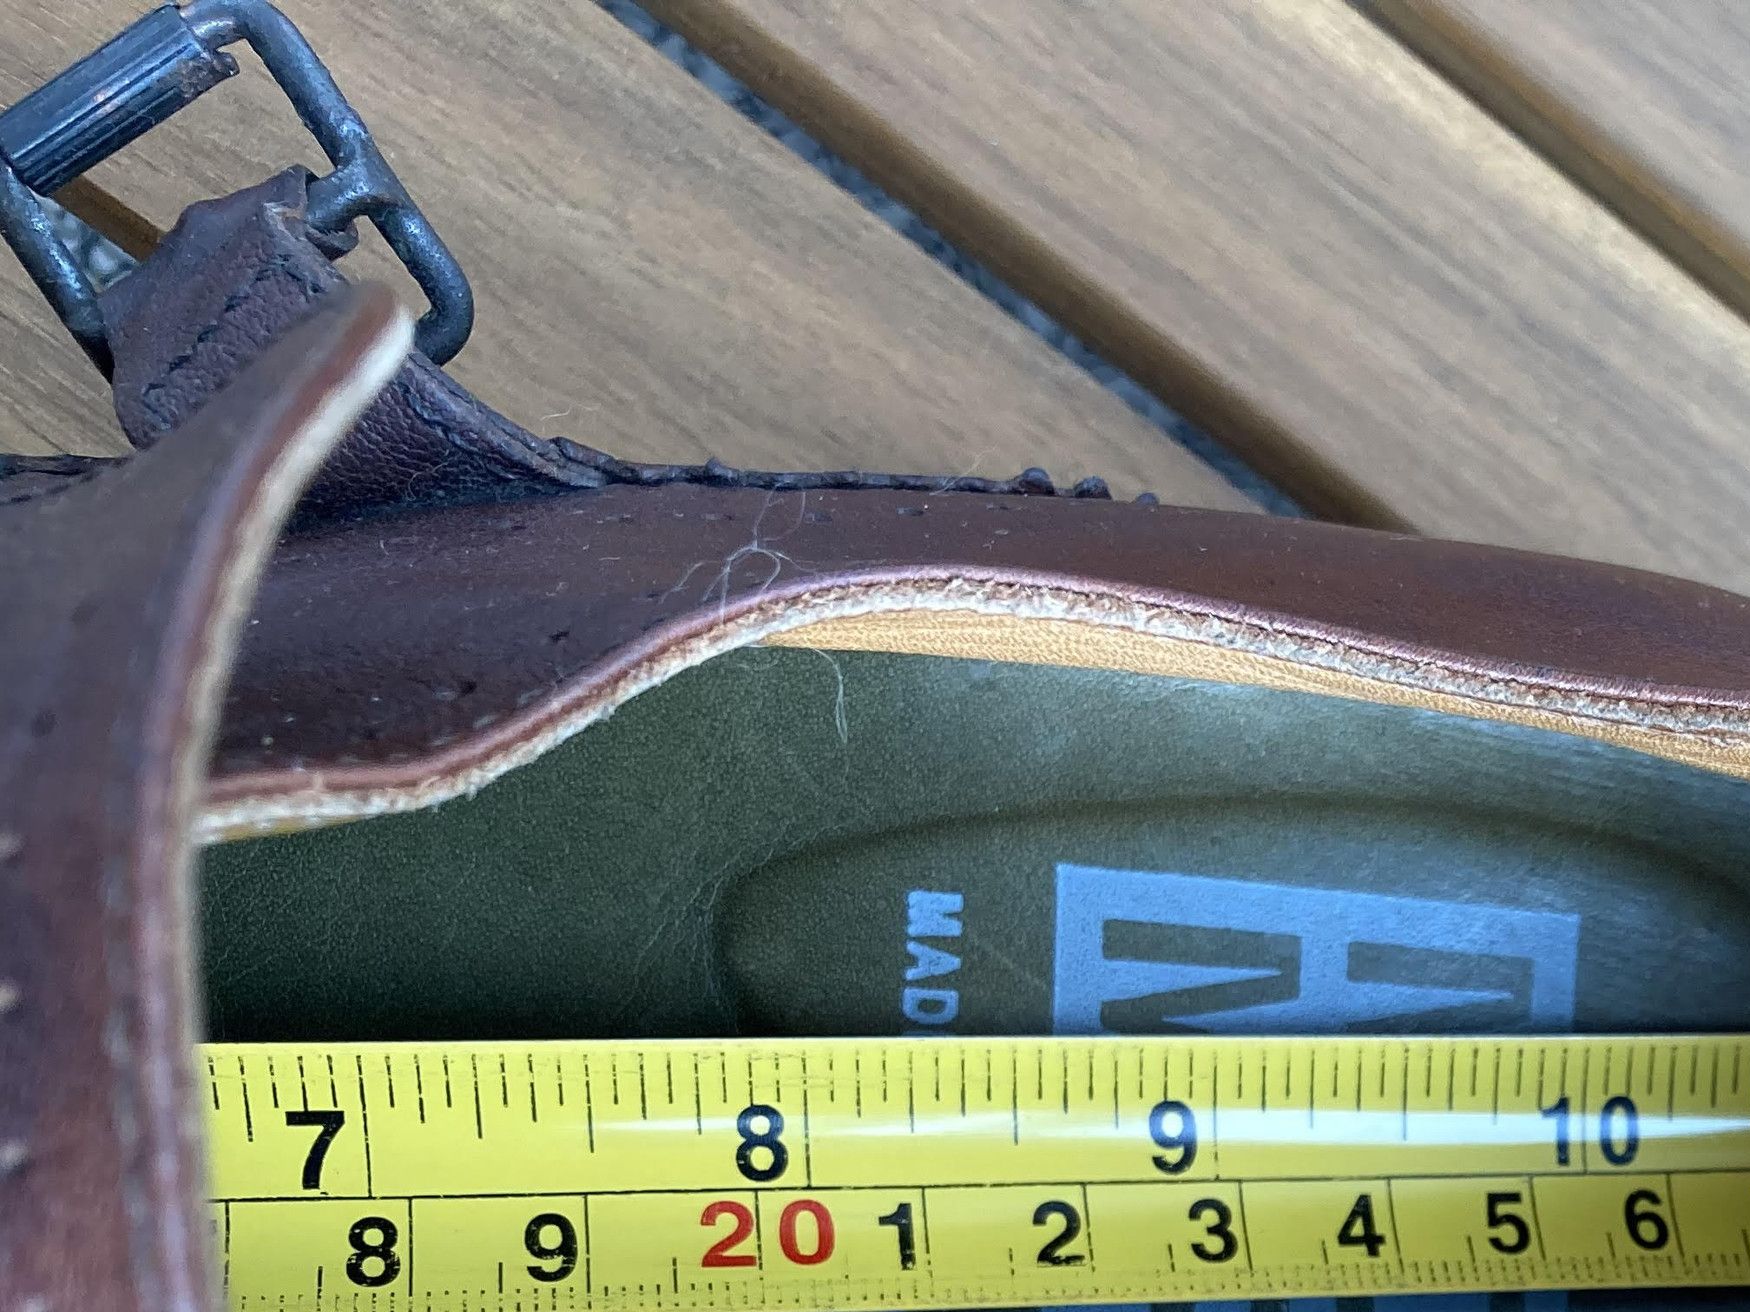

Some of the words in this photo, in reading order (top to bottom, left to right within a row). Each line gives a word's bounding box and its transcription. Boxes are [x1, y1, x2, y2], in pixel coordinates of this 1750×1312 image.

[902, 890, 965, 1037] MAD
[285, 1110, 345, 1189] 7
[736, 1104, 788, 1182] 8
[1149, 1100, 1197, 1175] 9
[1541, 1095, 1640, 1167] 10
[345, 1216, 400, 1287] 8
[524, 1213, 577, 1282] 9
[700, 1199, 835, 1268] 20
[878, 1203, 914, 1271] 1
[1032, 1201, 1085, 1267] 2
[1190, 1198, 1238, 1263] 3
[1337, 1194, 1384, 1259] 4
[1486, 1192, 1530, 1256] 5
[1623, 1189, 1669, 1251] 6
